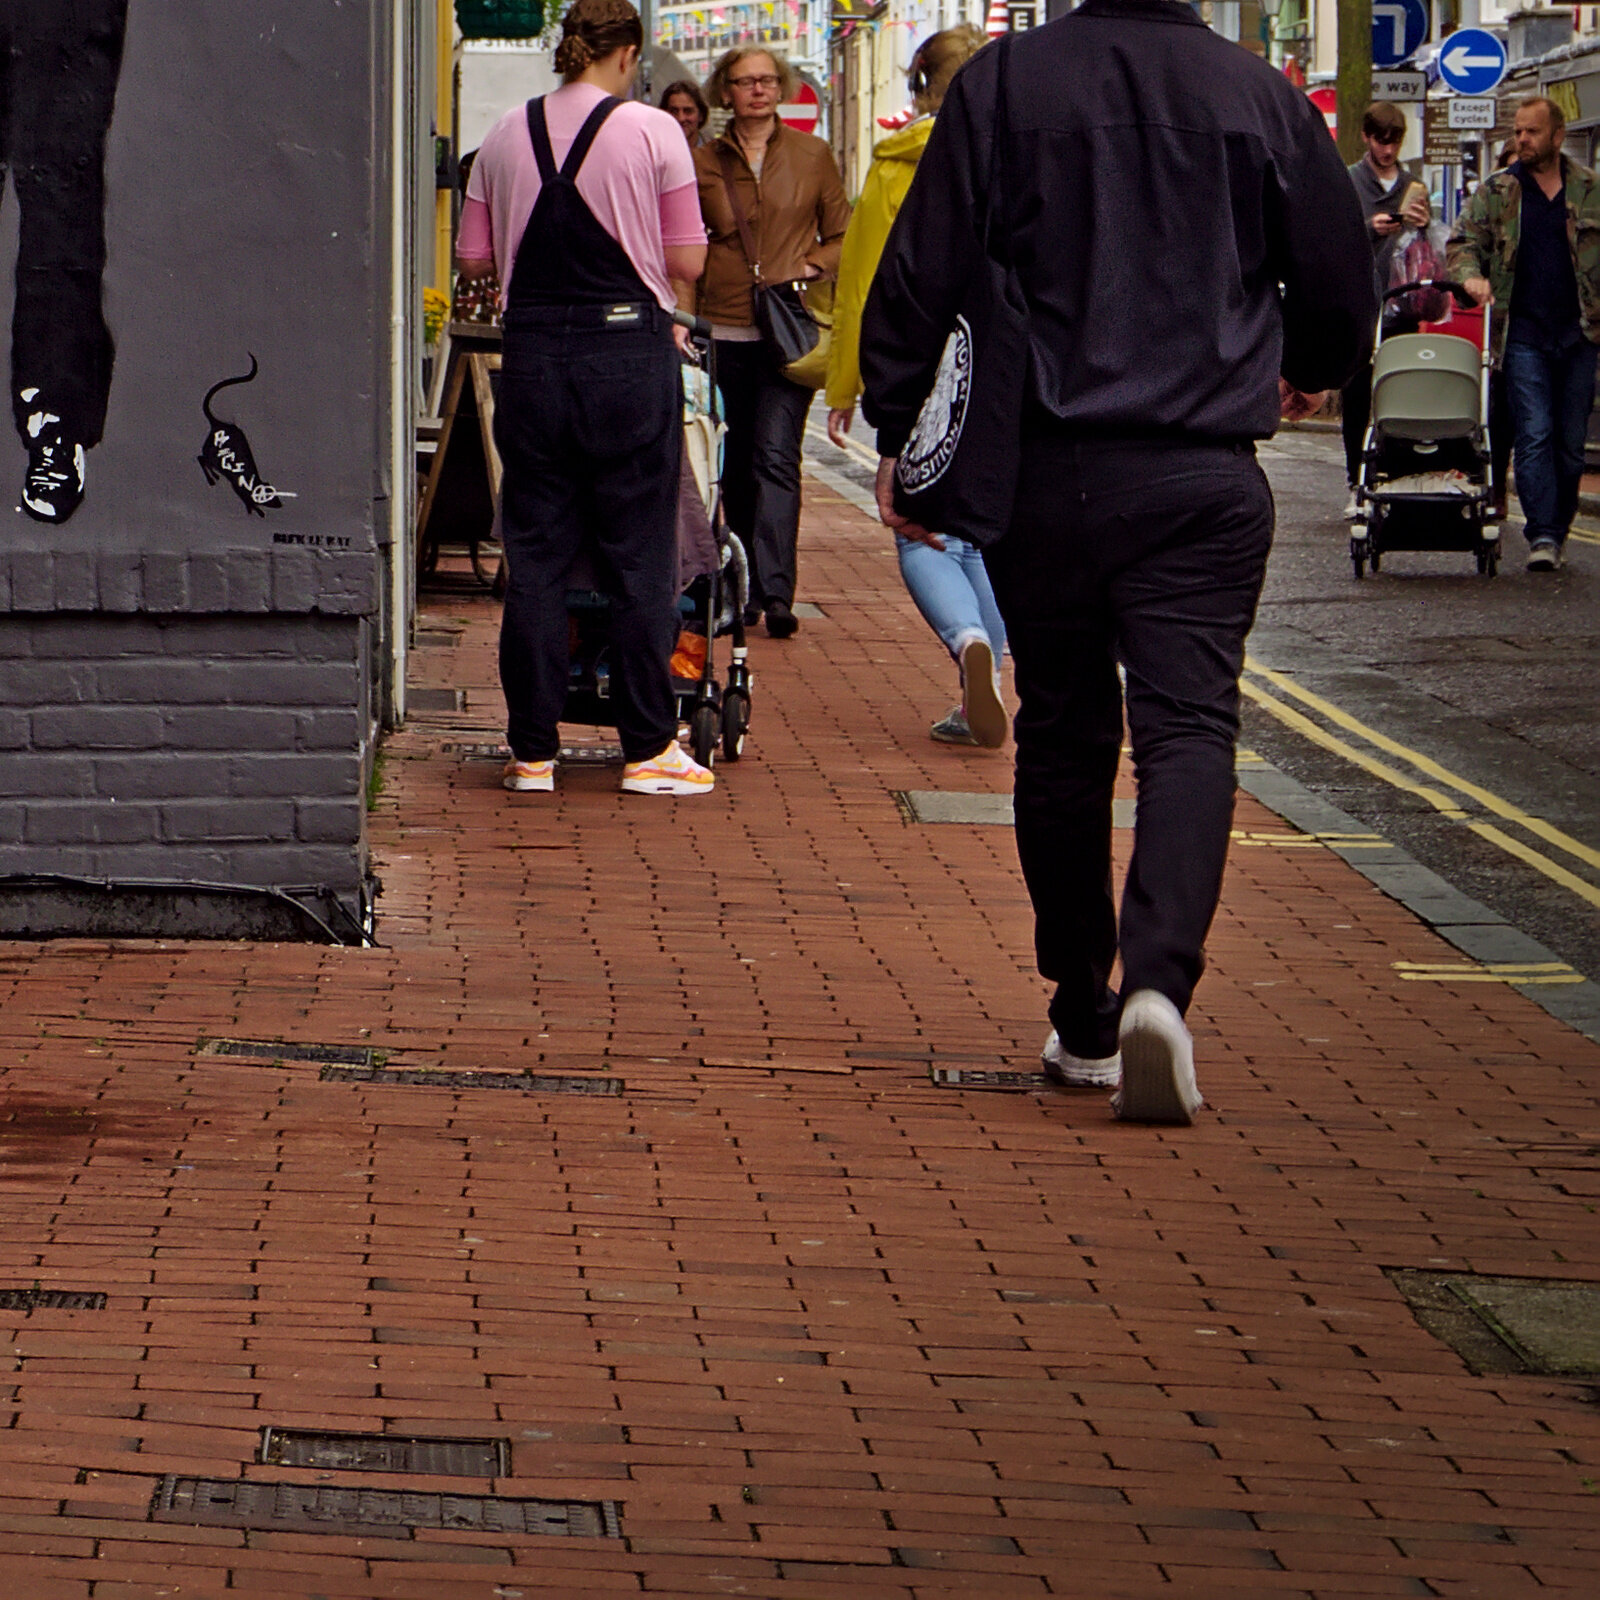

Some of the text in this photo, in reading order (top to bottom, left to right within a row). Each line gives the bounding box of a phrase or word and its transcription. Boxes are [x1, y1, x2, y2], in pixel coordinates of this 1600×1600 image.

[1386, 81, 1420, 95] way
[1452, 102, 1491, 113] Except
[1453, 114, 1489, 124] cycles
